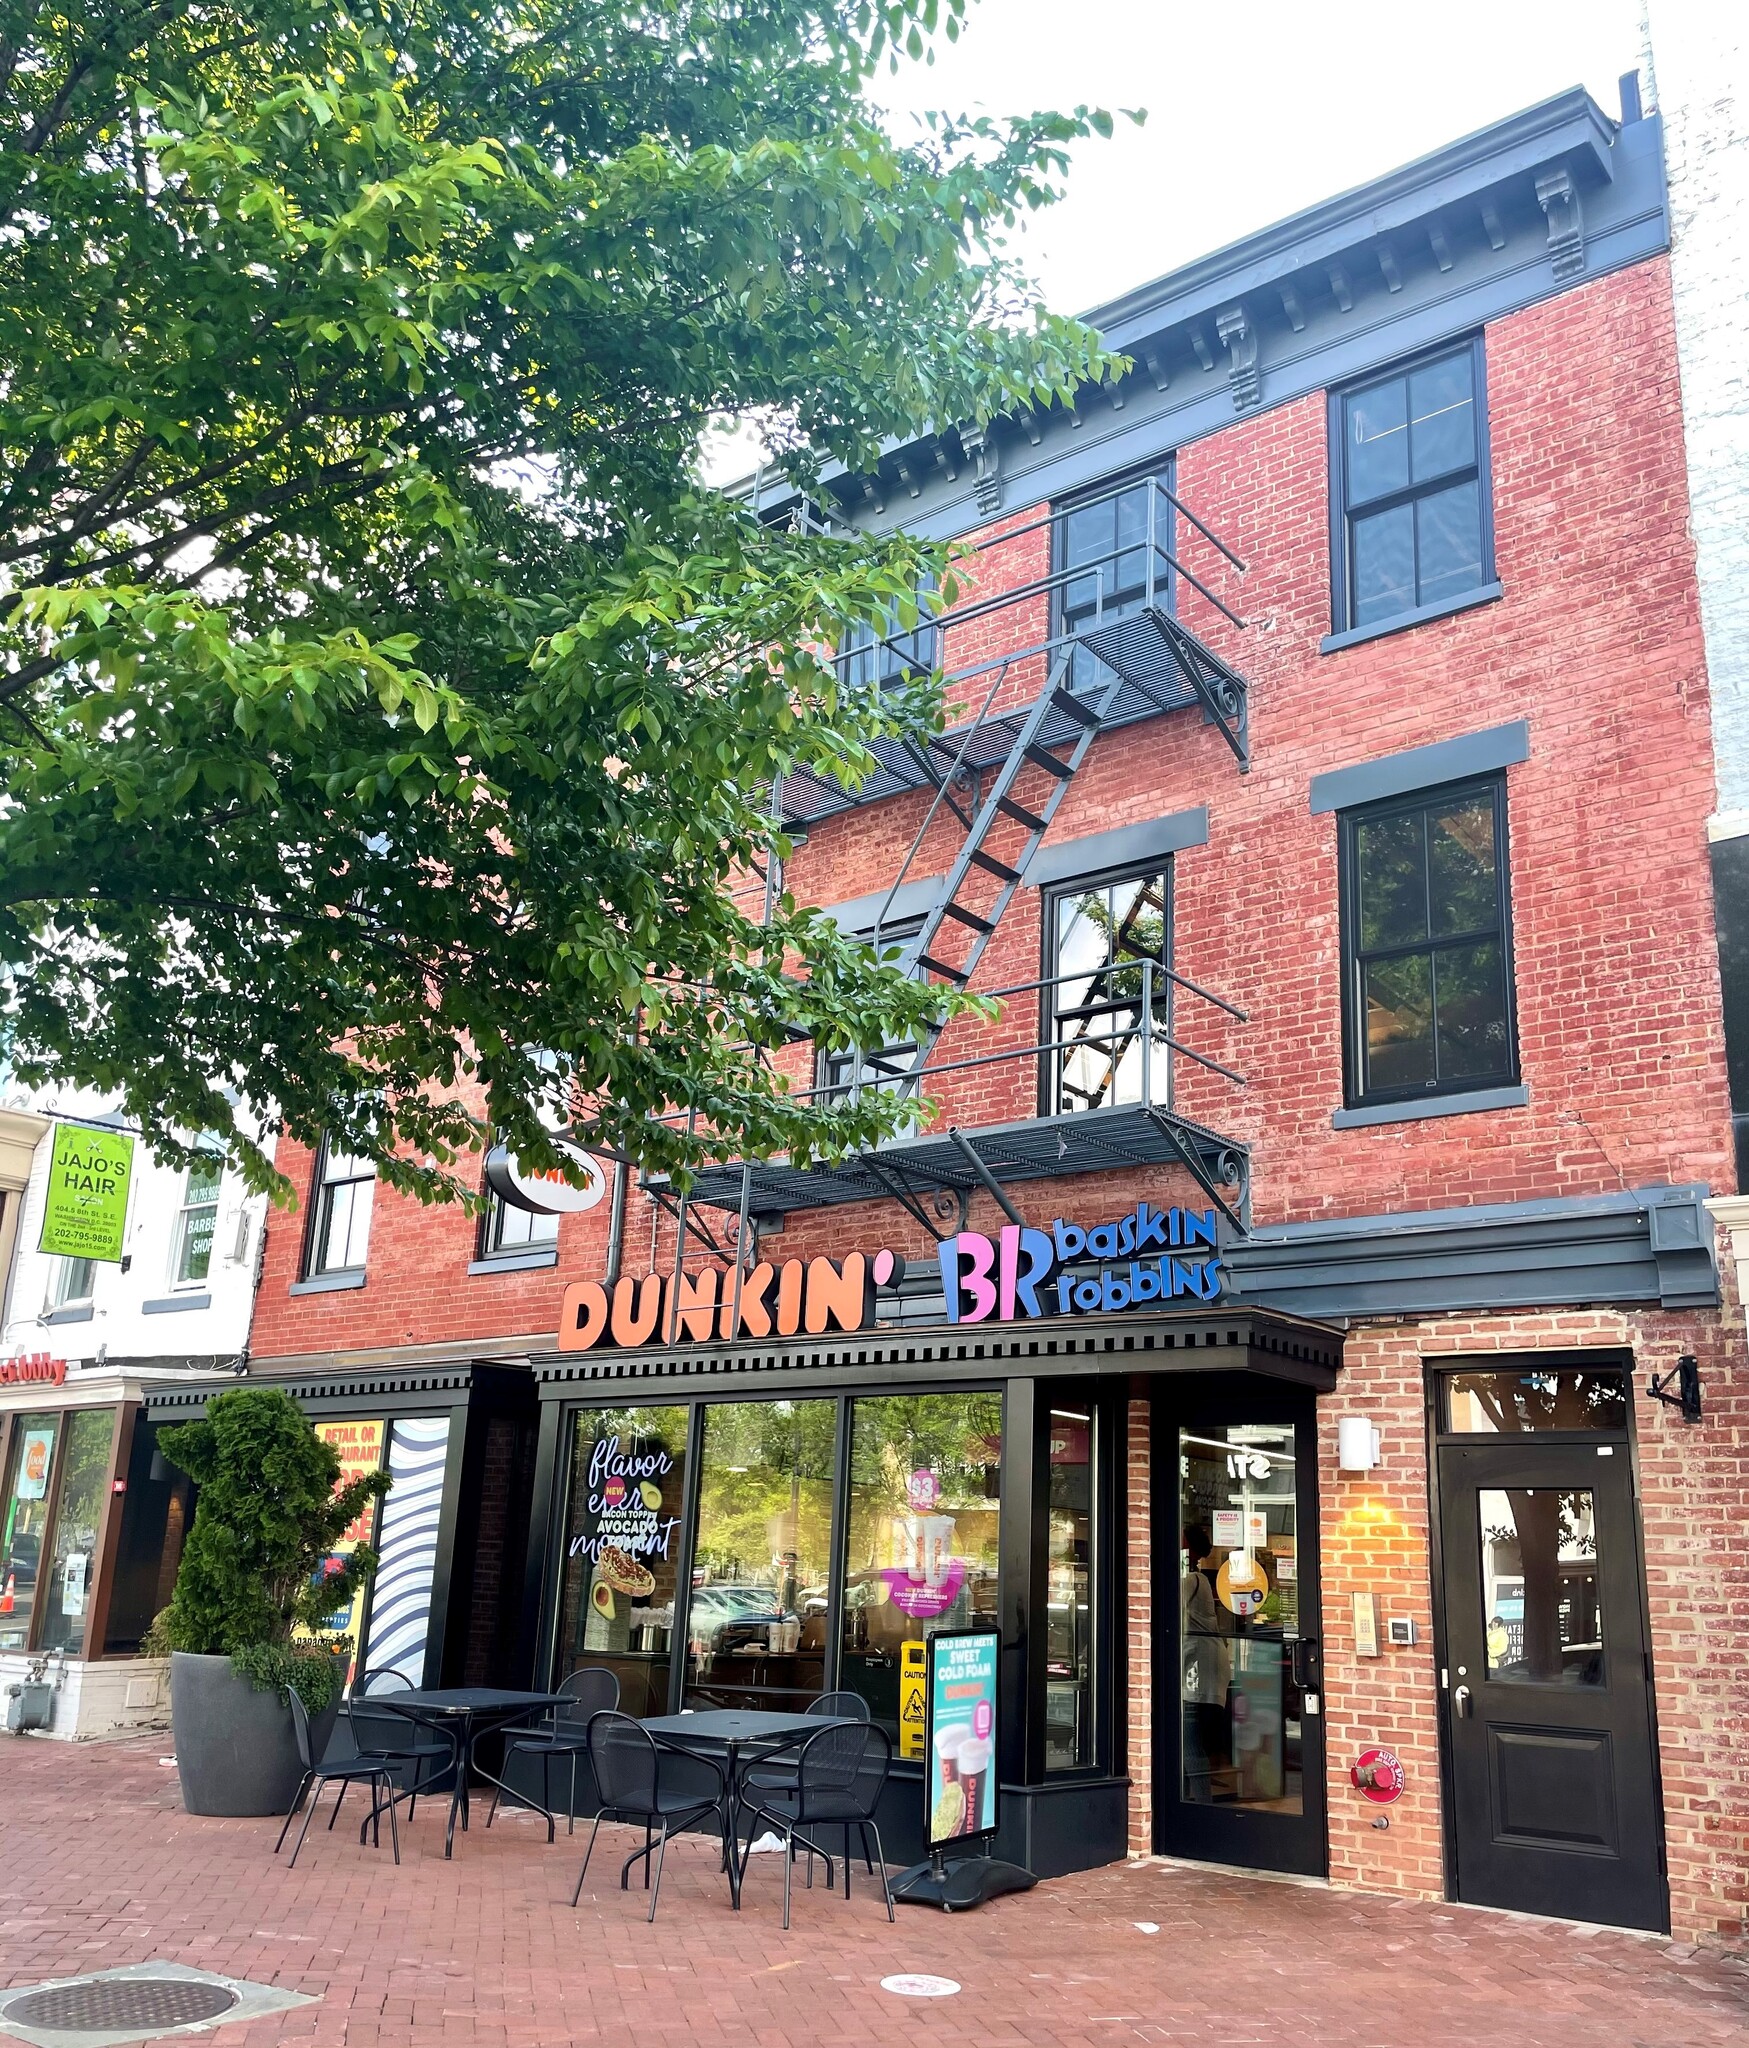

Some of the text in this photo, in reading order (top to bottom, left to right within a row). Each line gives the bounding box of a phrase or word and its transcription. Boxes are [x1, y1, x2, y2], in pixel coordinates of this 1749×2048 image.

[57, 1152, 126, 1176] JAJO'S
[64, 1171, 116, 1196] HAIR
[77, 1208, 89, 1216] 8th
[188, 1217, 217, 1235] BARBE
[54, 1228, 113, 1245] 202-795-9889
[58, 1239, 107, 1251] www.jajo15.com
[936, 1223, 1055, 1325] BR
[558, 1248, 897, 1353] DUNKIN'
[324, 1426, 376, 1444] RETAIL OR
[26, 1448, 47, 1471] food
[588, 1434, 674, 1489] flavor
[605, 1486, 625, 1497] NEW
[911, 1476, 934, 1497] $3
[601, 1510, 627, 1519] BACON
[596, 1519, 659, 1535] AVOCADO
[935, 1636, 994, 1651] COLD BREW MEETS
[950, 1648, 981, 1665] SWEET
[938, 1662, 992, 1681] COLD FOAM
